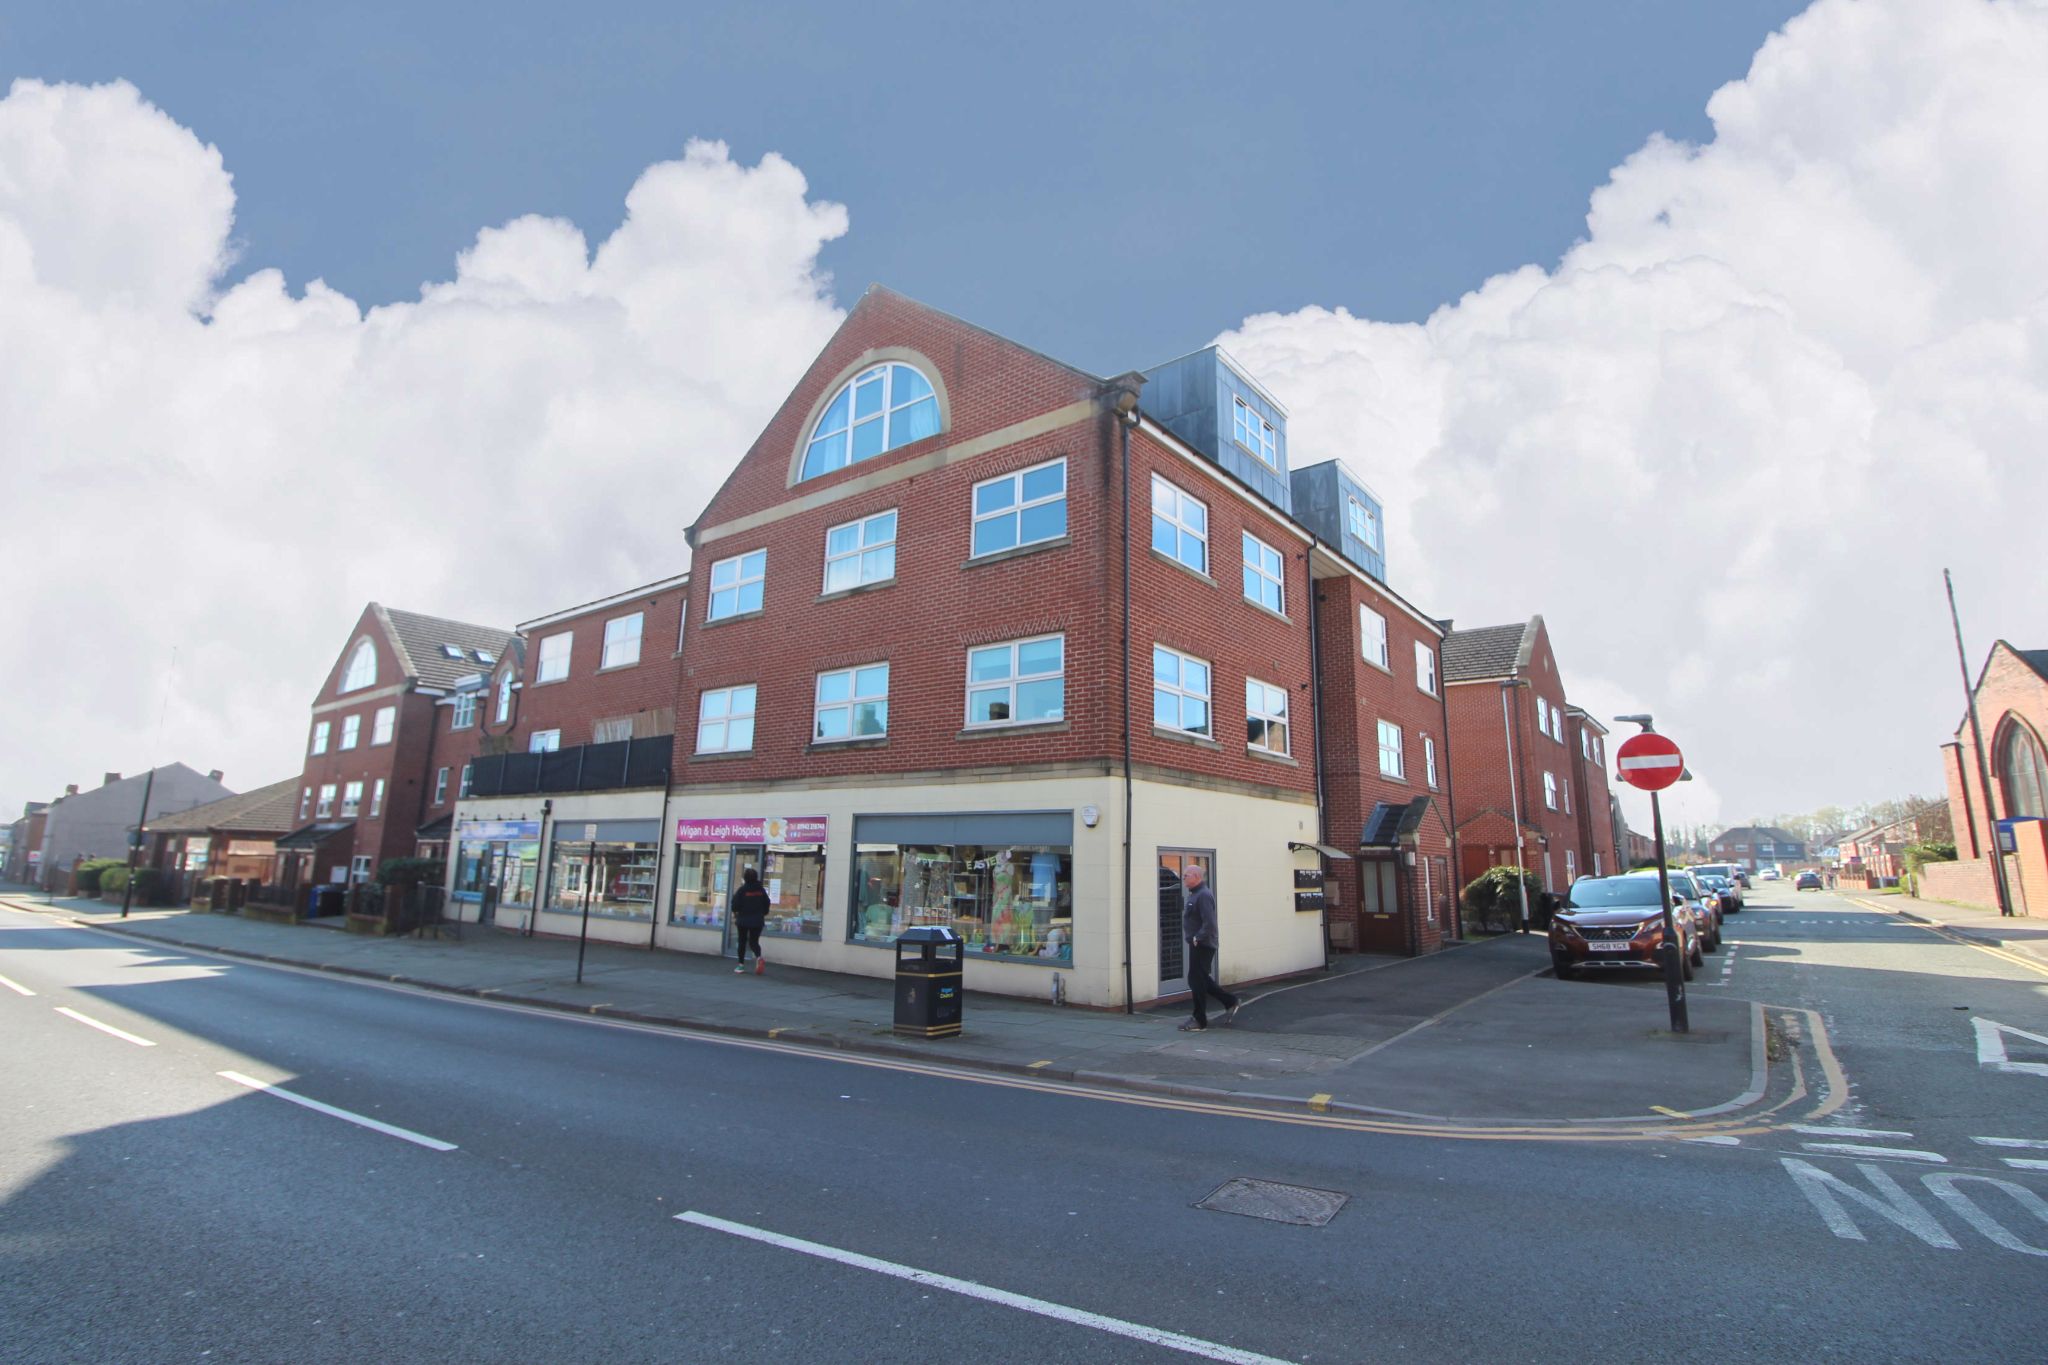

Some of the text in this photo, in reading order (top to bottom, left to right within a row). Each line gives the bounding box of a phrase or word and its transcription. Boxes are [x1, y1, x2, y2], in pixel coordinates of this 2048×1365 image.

[680, 824, 761, 839] Wigan & Leigh Hospice
